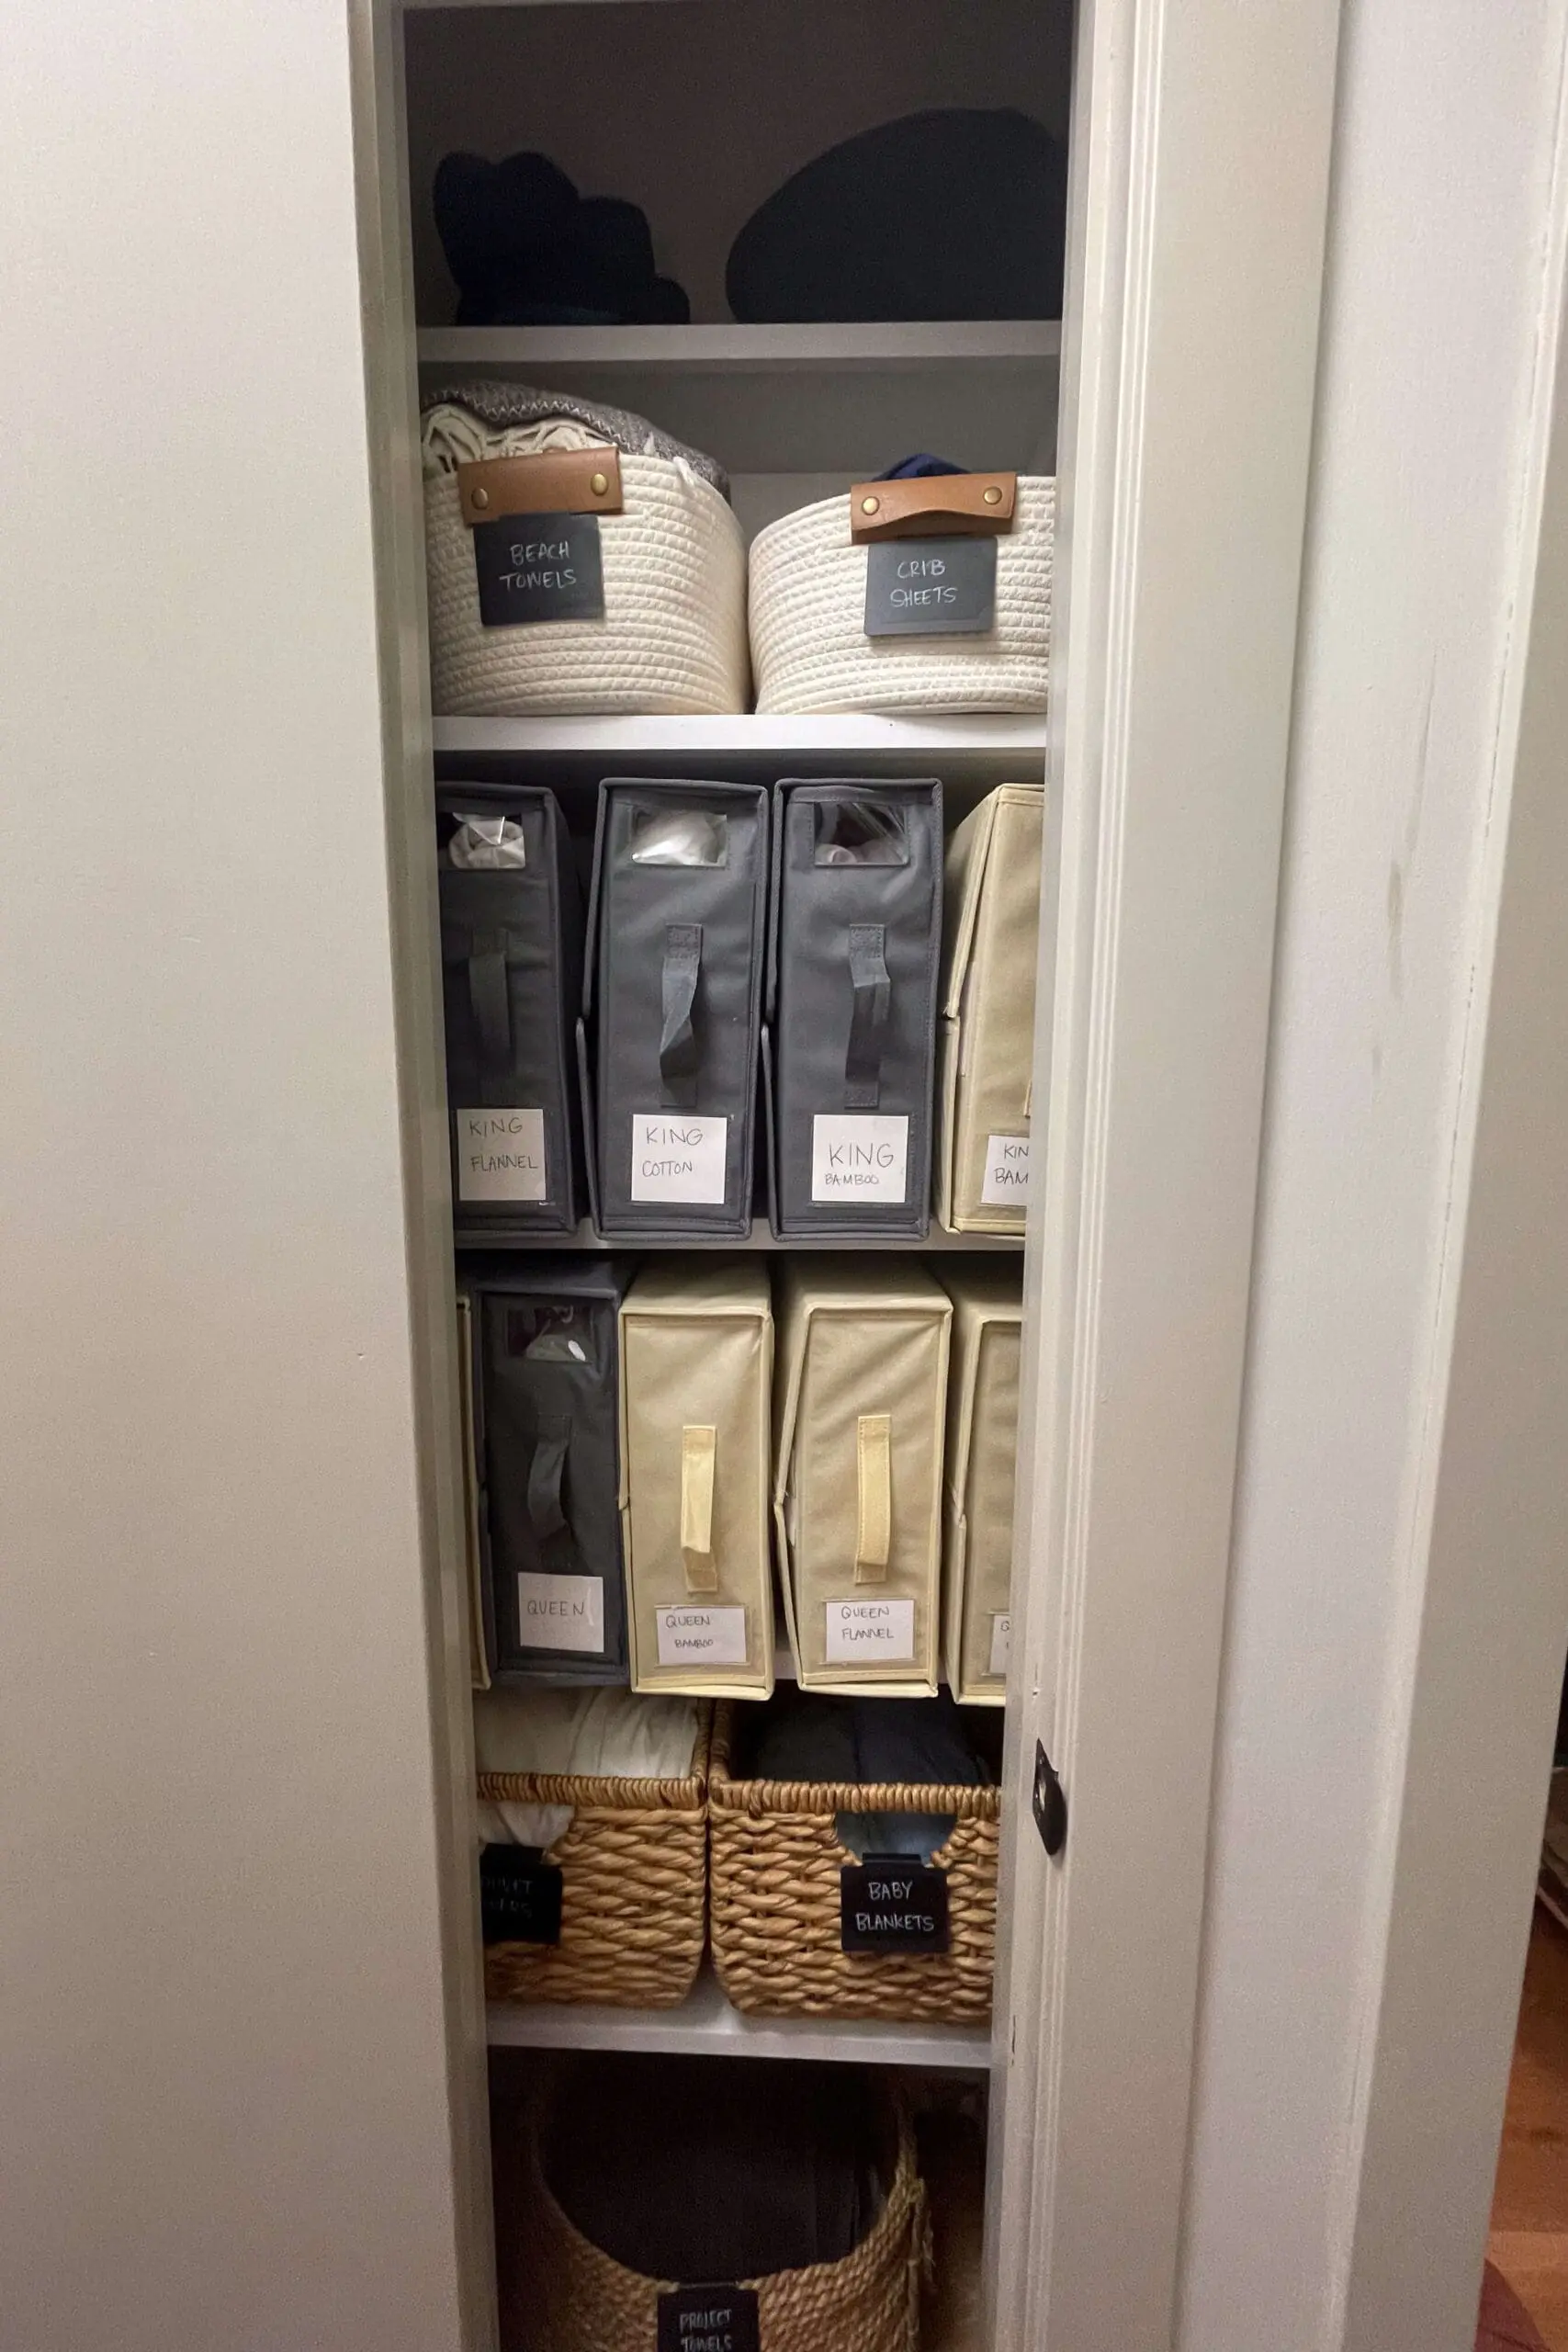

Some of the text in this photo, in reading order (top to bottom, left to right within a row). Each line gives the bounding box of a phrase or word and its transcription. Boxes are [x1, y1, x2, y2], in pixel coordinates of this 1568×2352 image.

[511, 540, 570, 566] BEACH
[897, 559, 946, 579] CRIB
[499, 569, 577, 592] TOWELS
[890, 585, 959, 607] SHEETS
[468, 1117, 523, 1136] KING
[646, 1126, 704, 1146] KING
[470, 1154, 538, 1172] FLANNEL
[829, 1142, 894, 1168] KING
[642, 1160, 693, 1177] COTTON
[825, 1173, 880, 1186] BAMBOO
[527, 1600, 585, 1616] QUEEN
[840, 1606, 890, 1619] QUEEN
[665, 1614, 710, 1628] QUEEN
[841, 1628, 895, 1641] FLANNEL
[868, 1881, 913, 1900] BABY
[855, 1912, 935, 1931] BLANKETS
[680, 2309, 732, 2332] PROJECT
